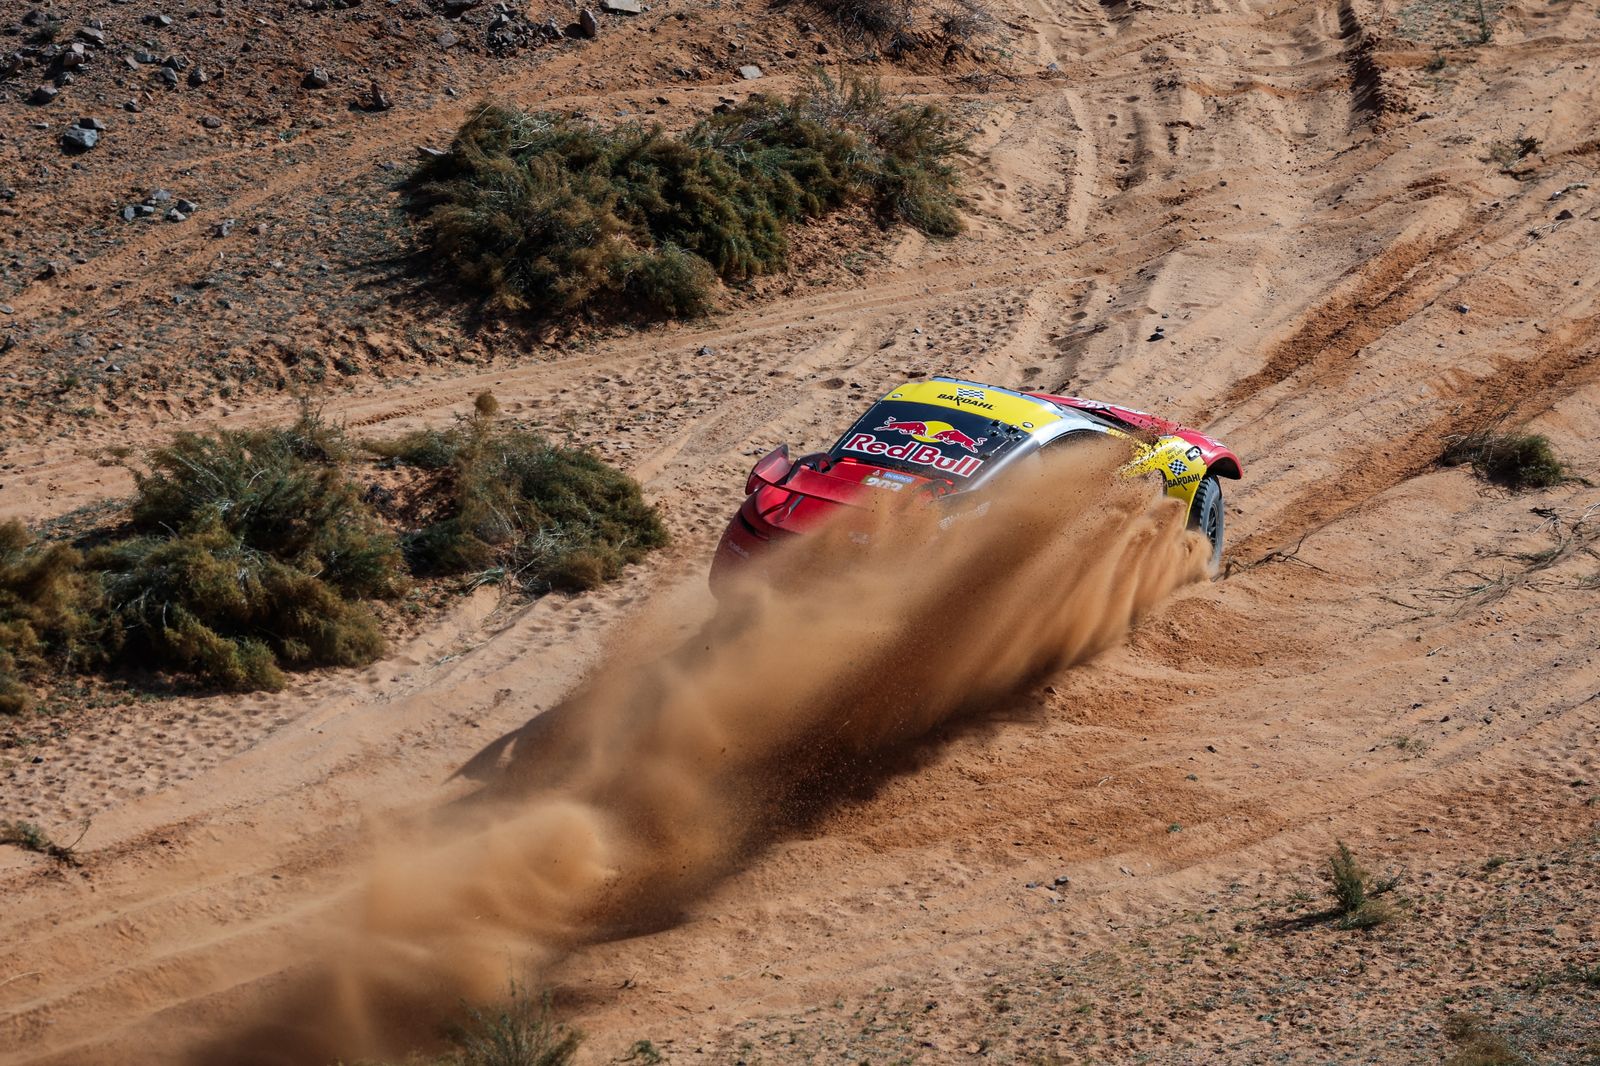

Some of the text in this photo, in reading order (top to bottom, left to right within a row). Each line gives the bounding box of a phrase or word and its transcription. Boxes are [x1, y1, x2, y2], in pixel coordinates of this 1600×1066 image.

[937, 393, 995, 410] BARDAHL
[841, 433, 920, 461] Red
[907, 444, 984, 478] Bull
